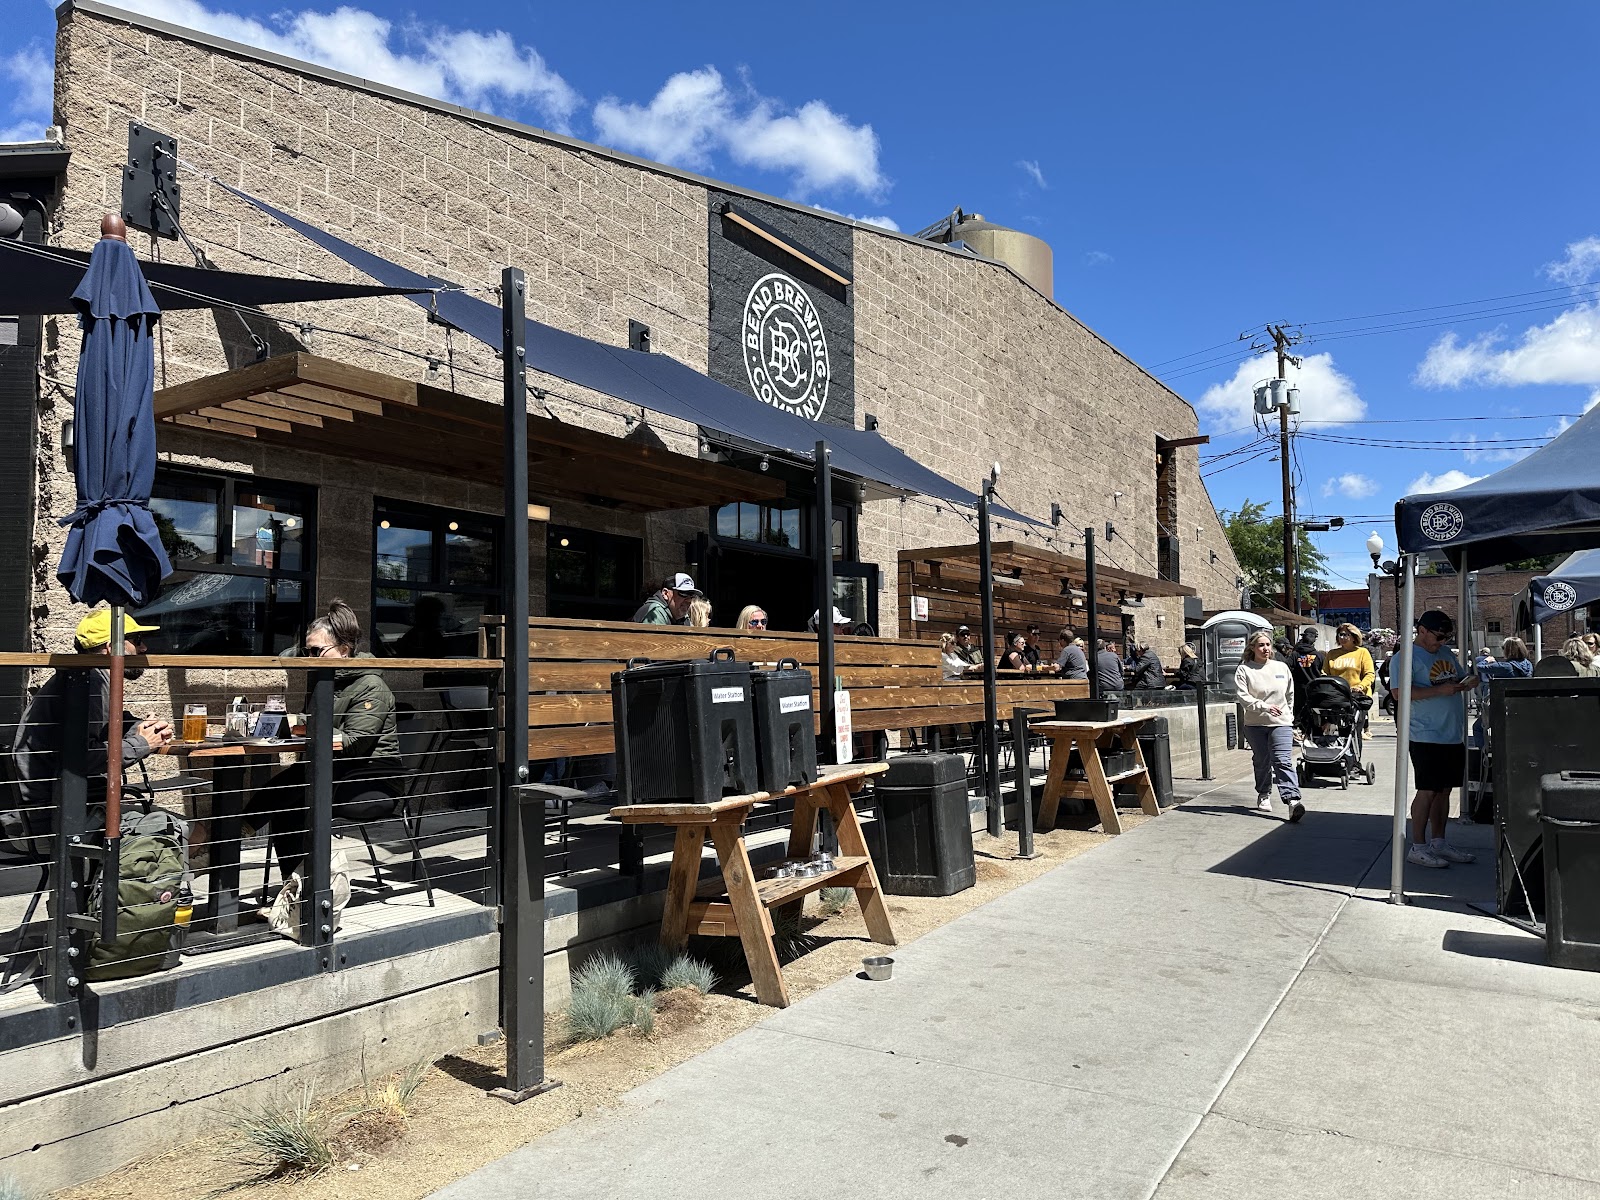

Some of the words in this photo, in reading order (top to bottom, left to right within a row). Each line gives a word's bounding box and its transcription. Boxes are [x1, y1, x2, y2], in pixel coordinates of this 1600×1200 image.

[747, 286, 773, 350] BEND
[773, 281, 827, 378] BREWING
[1422, 508, 1434, 527] BEND
[1433, 504, 1462, 524] BREWING
[1425, 525, 1459, 540] COMPANY
[1333, 656, 1357, 669] IOWA
[713, 692, 727, 700] Water
[727, 691, 743, 699] Station
[793, 700, 807, 708] Station
